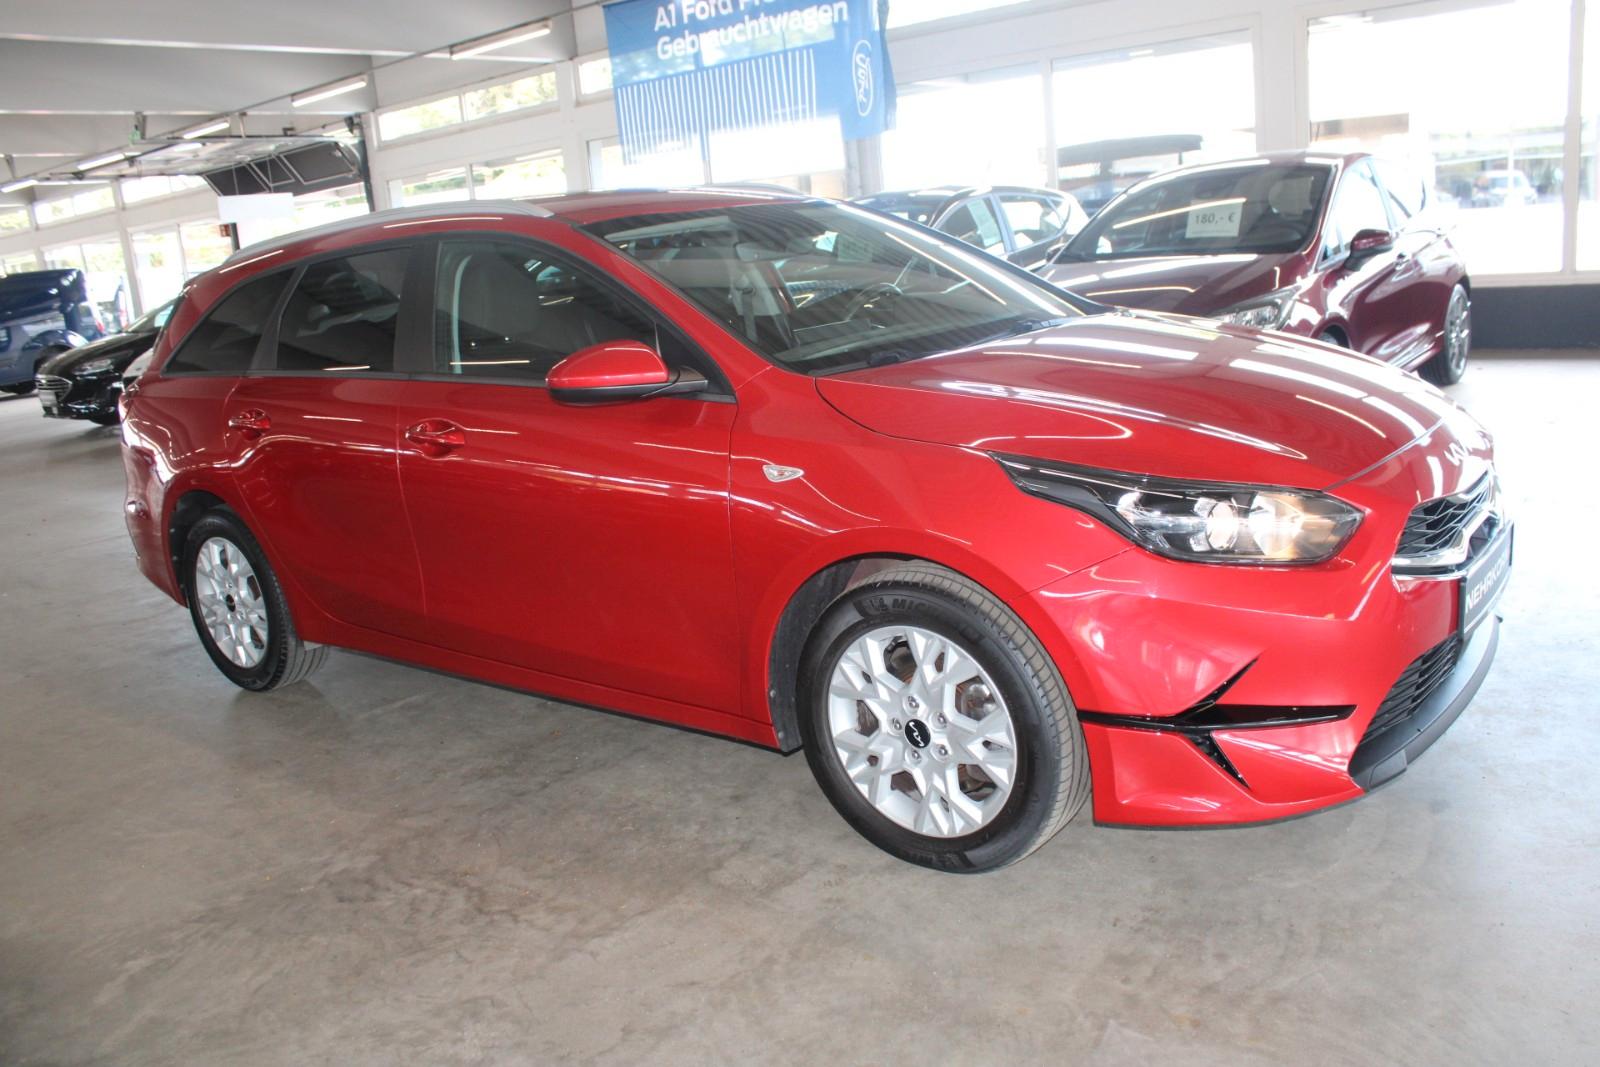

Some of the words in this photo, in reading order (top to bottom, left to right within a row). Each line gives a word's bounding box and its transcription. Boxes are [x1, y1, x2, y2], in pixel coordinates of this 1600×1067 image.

[655, 3, 677, 31] A1
[681, 0, 733, 24] Ford
[656, 0, 849, 60] Gebrauchtwagen
[1466, 549, 1507, 613] NEHRKO
